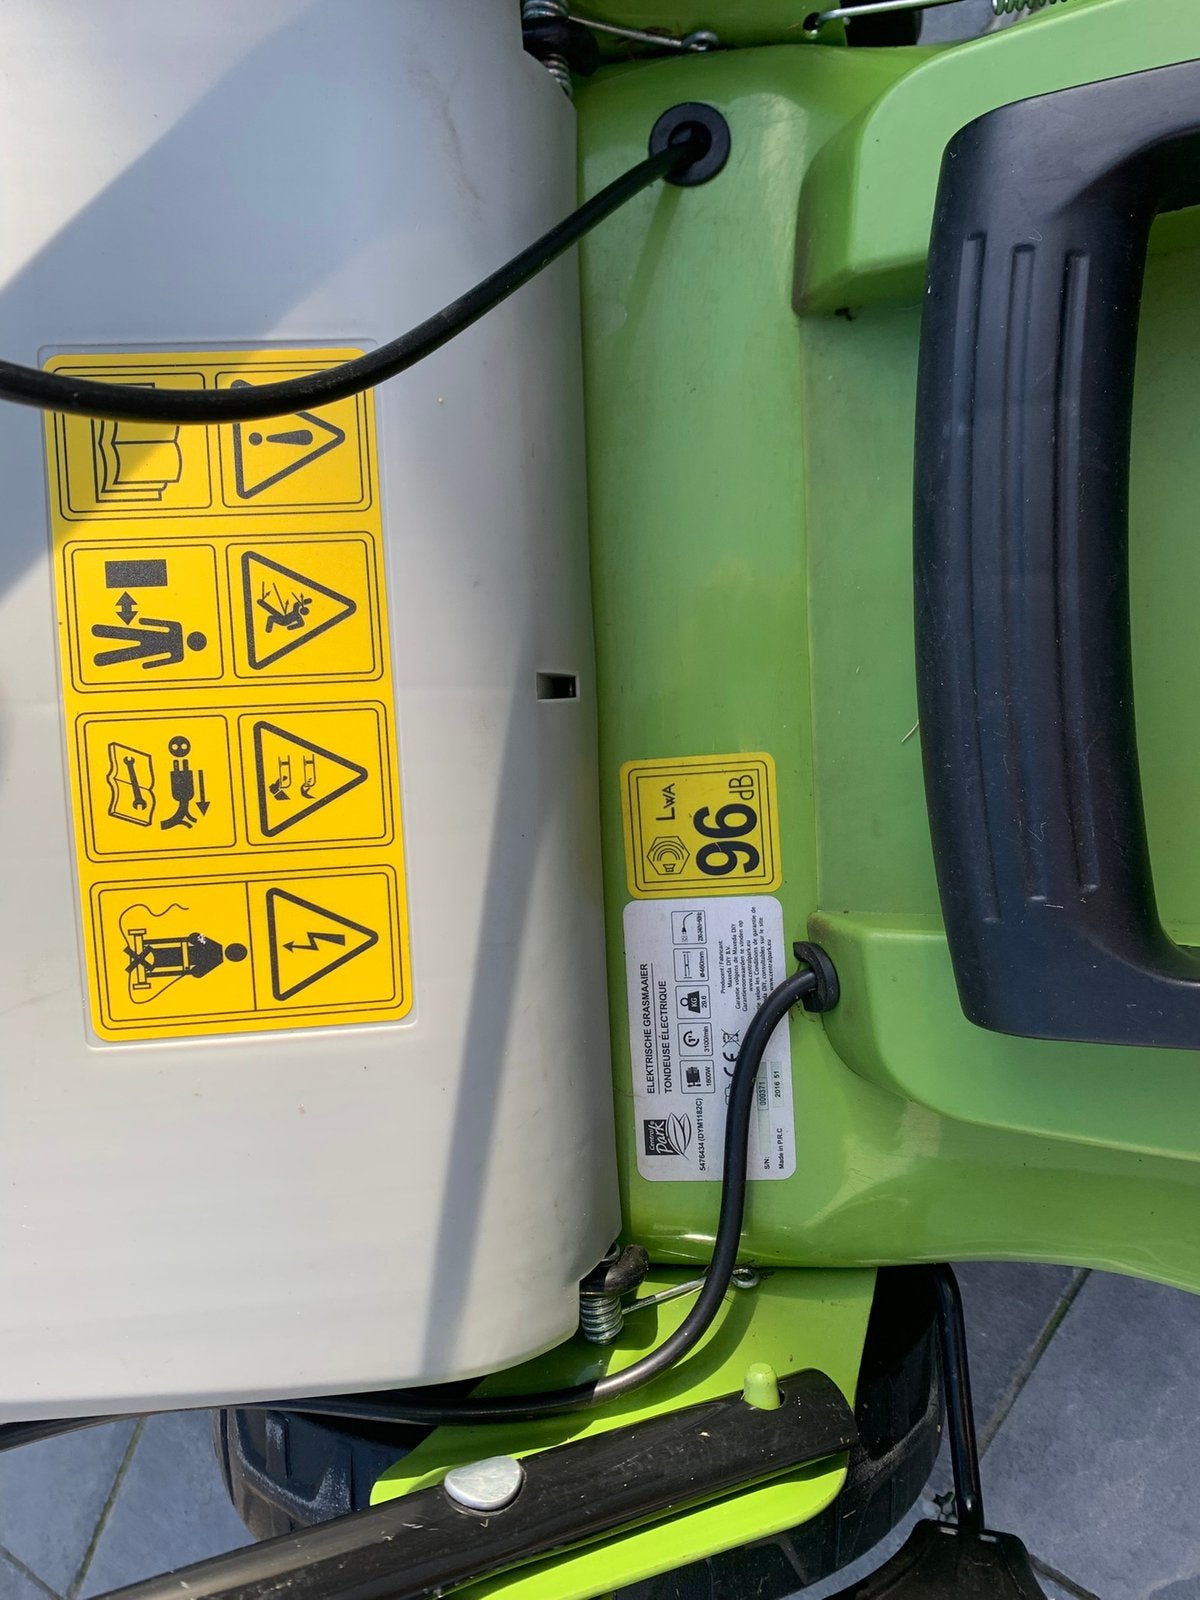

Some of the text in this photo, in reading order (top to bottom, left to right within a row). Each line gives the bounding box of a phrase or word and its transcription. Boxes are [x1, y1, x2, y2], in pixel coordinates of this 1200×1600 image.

[693, 775, 760, 876] 96 dB
[640, 964, 655, 1093] ELEKTRISCHE GRASMAAIER
[658, 981, 672, 1093] TONDEUSE ÉLECTRIQUE
[691, 998, 697, 1006] KG
[648, 1121, 673, 1153] Park
[696, 1098, 706, 1171] 5476434 (DYM1182C)
